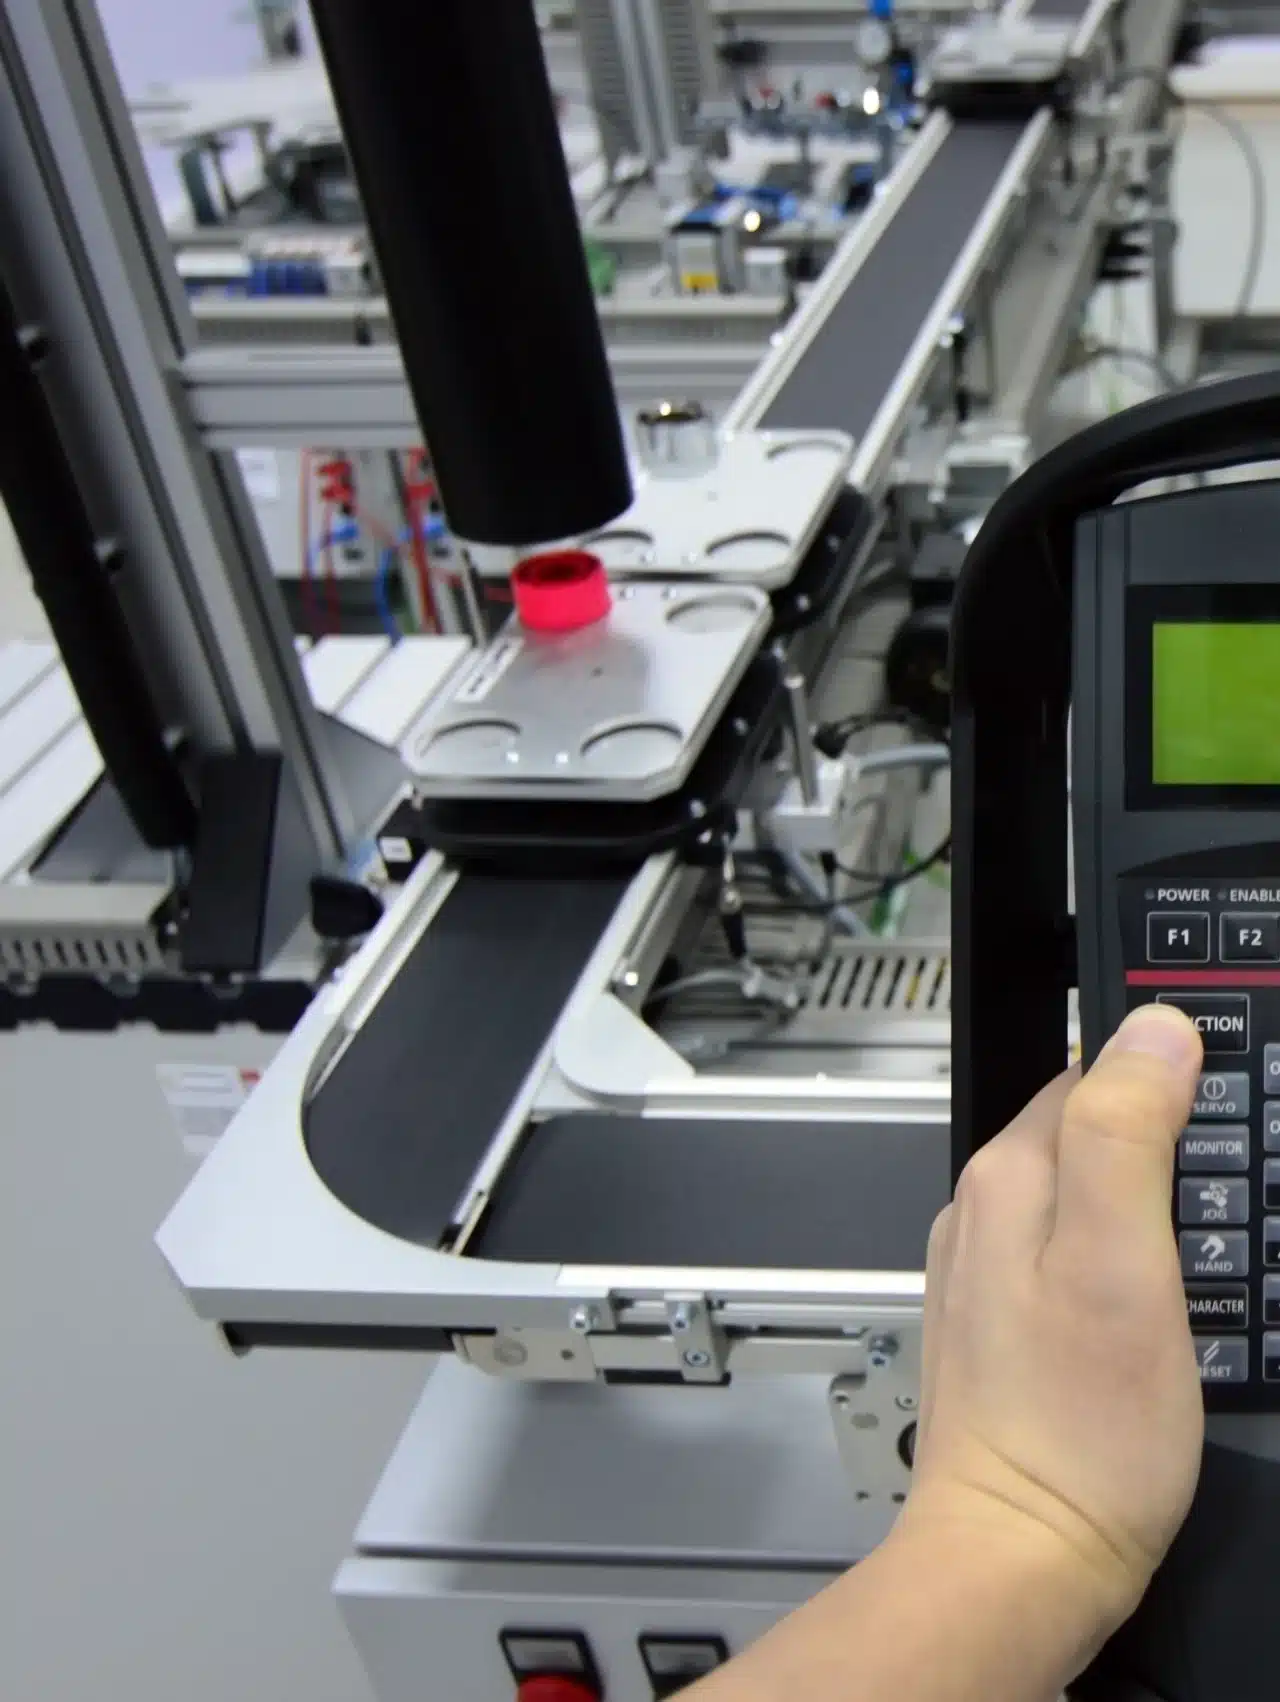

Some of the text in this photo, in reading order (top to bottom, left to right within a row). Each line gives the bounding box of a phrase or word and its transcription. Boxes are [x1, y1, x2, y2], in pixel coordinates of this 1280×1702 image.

[1157, 888, 1210, 902] POWER
[1168, 928, 1190, 946] F1
[1239, 928, 1263, 946] F2
[1191, 1016, 1244, 1032] CTION
[1193, 1101, 1236, 1114] SERVO
[1185, 1141, 1243, 1155] MONITOR
[1202, 1209, 1228, 1221] JOG
[1194, 1261, 1233, 1273] HAND
[1187, 1299, 1245, 1314] HARACTER
